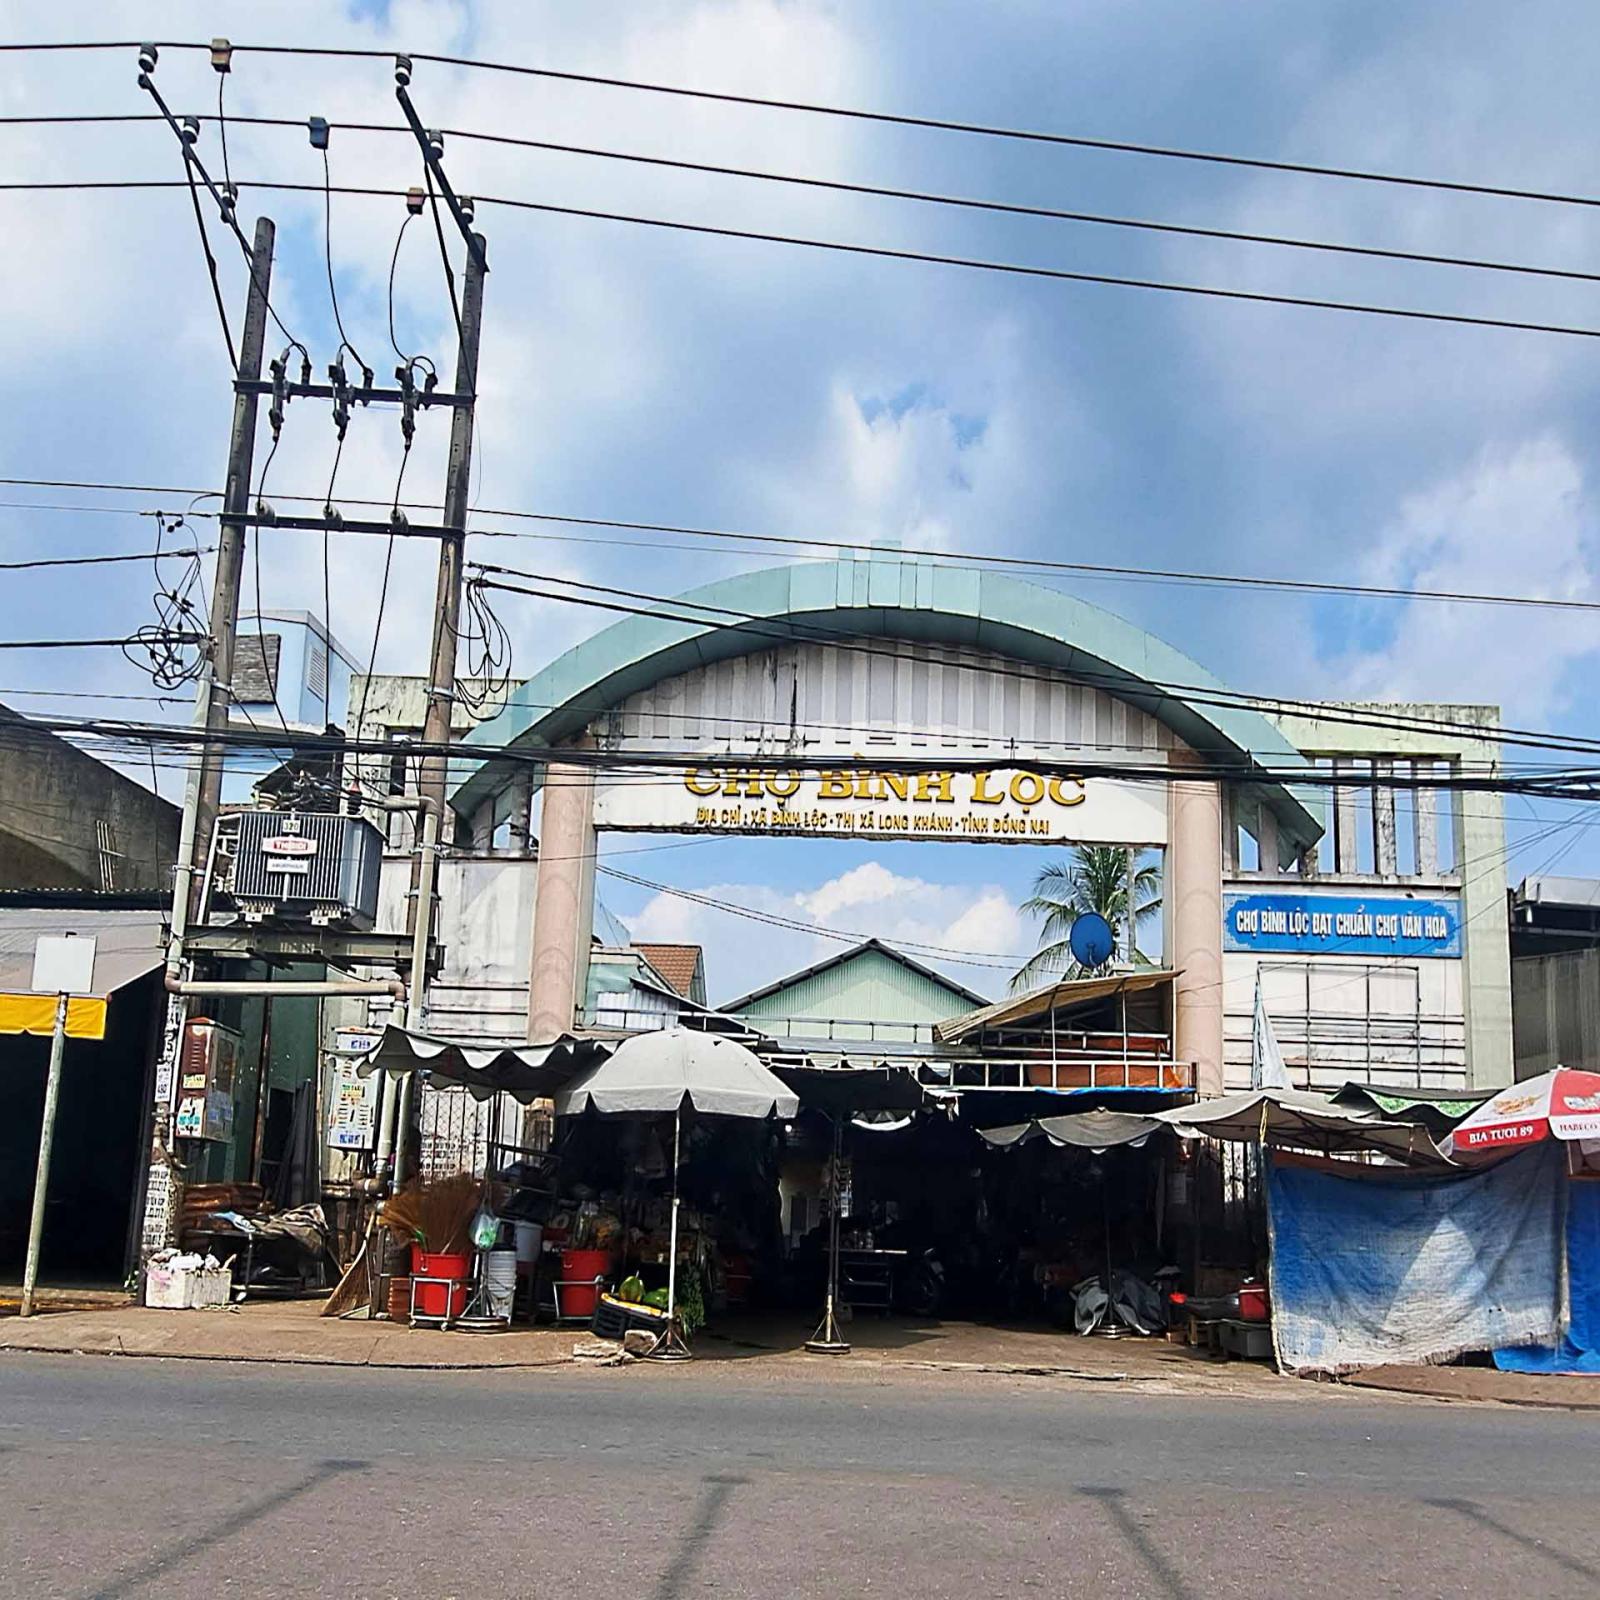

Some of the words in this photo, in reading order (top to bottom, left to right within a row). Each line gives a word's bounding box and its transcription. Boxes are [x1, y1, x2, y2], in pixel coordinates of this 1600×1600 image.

[879, 814, 908, 830] LONG
[914, 812, 953, 831] KHÁNH
[1030, 819, 1049, 835] NAI
[1236, 910, 1258, 938] CHỢ
[1261, 906, 1286, 935] BÌNH
[1289, 906, 1309, 939] LỘC
[1376, 914, 1397, 942] CHỢ
[1469, 1132, 1488, 1144] BIA
[1519, 1125, 1534, 1137] 89
